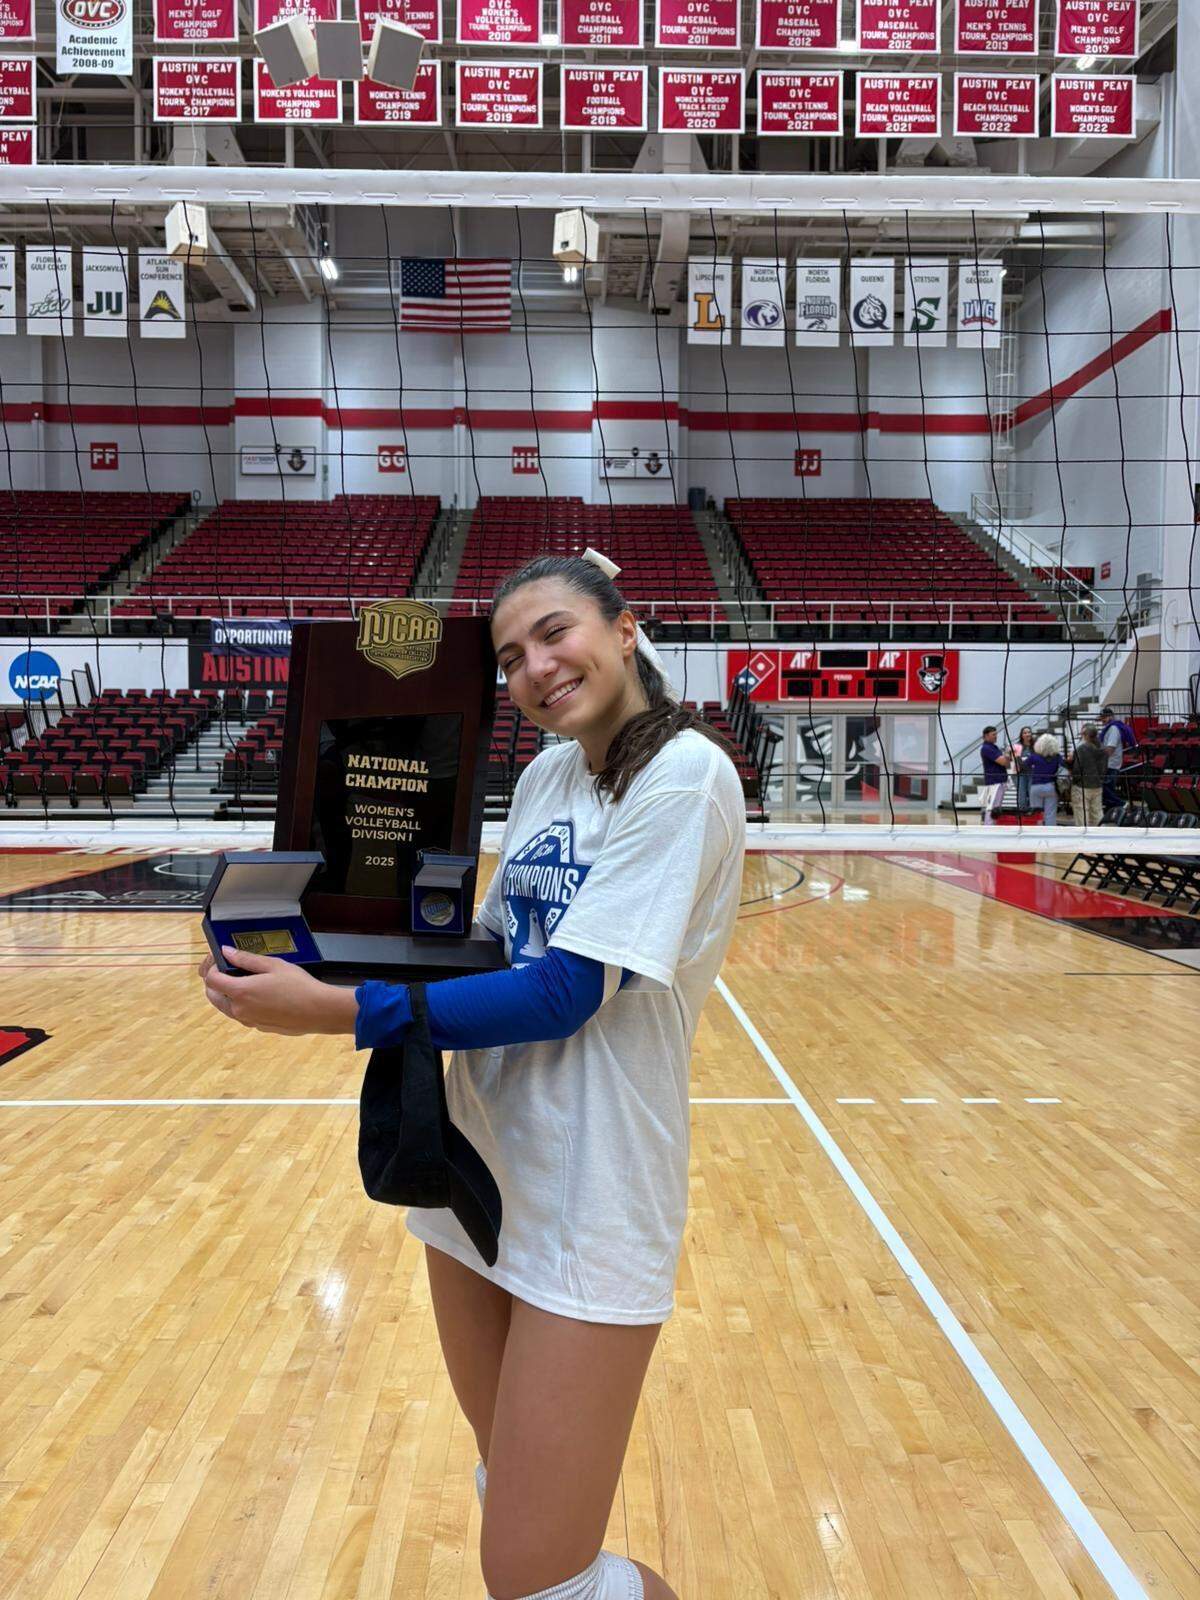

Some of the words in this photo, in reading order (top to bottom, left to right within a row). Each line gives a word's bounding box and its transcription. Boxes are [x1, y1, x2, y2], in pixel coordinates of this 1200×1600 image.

[386, 0, 411, 8] OVC
[489, 0, 512, 9] OVC
[590, 3, 612, 12] OVC
[687, 3, 710, 12] OVC
[1005, 0, 1030, 8] PEAY
[1065, 1, 1100, 10] AUSTIN
[1107, 2, 1131, 11] PEAY
[74, 1, 112, 17] OVC
[481, 8, 519, 16] WOMEN'S
[788, 5, 810, 14] OVC
[888, 9, 910, 18] OVC
[169, 10, 192, 18] MEN'S
[202, 10, 222, 18] GOLF
[407, 12, 434, 20] TENNIS
[986, 10, 1008, 19] OVC
[1087, 13, 1109, 22] OVC
[174, 20, 218, 28] CHAMPIONS
[475, 16, 524, 24] VOLLEYBALL
[579, 15, 621, 24] BASEBALL
[677, 15, 718, 25] BASEBALL
[778, 18, 819, 26] BASEBALL
[496, 24, 532, 32] CHAMPIONS
[577, 25, 624, 34] CHAMPIONS
[877, 21, 919, 30] BASEBALL
[966, 22, 991, 31] MEN'S
[998, 23, 1026, 31] TENNIS
[1070, 25, 1096, 34] MEN'S
[1103, 26, 1125, 34] GOLF
[691, 27, 735, 35] CHAMPIONS
[776, 28, 821, 37] CHAMPIONS
[69, 35, 118, 45] Academic
[488, 32, 512, 40] 2010
[590, 35, 611, 43] 2011
[688, 35, 709, 44] 2011
[891, 32, 935, 40] CHAMPIONS
[960, 32, 988, 40] TOURN.
[991, 33, 1034, 41] CHAMPIONS
[1075, 36, 1121, 44] CHAMPIONS
[788, 37, 812, 46] 2012
[888, 40, 912, 49] 2012
[985, 41, 1009, 50] 2013
[61, 47, 125, 57] Achievement
[1085, 45, 1109, 53] 2013
[1, 62, 28, 72] PEAY
[72, 58, 114, 69] 2008-09
[162, 63, 198, 73] AUSTIN
[206, 63, 233, 73] PEAY
[464, 68, 500, 78] AUSTIN
[508, 69, 535, 79] PEAY
[569, 71, 605, 81] AUSTIN
[613, 72, 639, 82] PEAY
[186, 75, 208, 84] OVC
[667, 74, 703, 84] AUSTIN
[711, 74, 737, 84] PEAY
[765, 77, 801, 86] AUSTIN
[809, 77, 835, 87] PEAY
[488, 80, 510, 90] OVC
[593, 83, 615, 93] OVC
[864, 79, 900, 89] AUSTIN
[908, 80, 933, 89] PEAY
[962, 79, 998, 88] AUSTIN
[1005, 80, 1031, 90] PEAY
[1059, 80, 1095, 90] AUSTIN
[1103, 81, 1128, 91] PEAY
[159, 88, 190, 96] WOMEN'S
[192, 88, 235, 96] VOLLEYBALL
[369, 91, 400, 99] WOMEN'S
[691, 86, 713, 95] OVC
[789, 88, 811, 98] OVC
[470, 93, 501, 101] WOMEN'S
[503, 94, 528, 102] TENNIS
[888, 91, 910, 100] OVC
[986, 91, 1008, 100] OVC
[1083, 92, 1104, 101] OVC
[191, 98, 235, 107] CHAMPIONS
[276, 100, 321, 108] CHAMPIONS
[586, 97, 621, 105] FOOTBALL
[772, 101, 802, 110] WOMEN'S
[804, 102, 829, 110] TENNIS
[376, 102, 420, 110] CHAMPIONS
[493, 104, 536, 112] CHAMPIONS
[866, 103, 889, 112] BEACH
[890, 104, 932, 112] VOLLEYBALL
[963, 103, 987, 112] BEACH
[988, 104, 1030, 112] VOLLEYBALL
[1069, 105, 1099, 113] WOMEN'S
[1101, 105, 1118, 113] GOLF
[183, 107, 210, 116] 2017
[285, 109, 312, 117] 2018
[385, 111, 411, 120] 2019
[582, 107, 625, 115] CHAMPIONS
[486, 112, 513, 122] 2019
[590, 116, 617, 125] 2019
[794, 112, 838, 120] CHAMPIONS
[892, 114, 935, 122] CHAMPIONS
[974, 114, 1018, 122] CHAMPIONS
[1072, 115, 1115, 123] CHAMPIONS
[687, 119, 716, 128] 2020
[787, 120, 813, 130] 2021
[885, 122, 912, 132] 2021
[981, 122, 1011, 132] 2022
[1079, 123, 1108, 132] 2022
[2, 132, 28, 142] PEAY
[141, 273, 182, 281] CONFERENCE
[861, 275, 884, 283] QUEENS
[87, 291, 123, 316] JU
[694, 293, 725, 331] L
[93, 448, 116, 465] FF
[379, 450, 405, 467] GG
[514, 452, 538, 468] HH
[361, 611, 439, 645] NJCAA
[202, 653, 289, 682] AUSTIN
[14, 675, 59, 689] NCAA
[347, 754, 429, 774] NATIONAL
[345, 773, 429, 793] CHAMPION
[354, 804, 415, 817] WOMEN'S
[344, 815, 421, 830] VOLLEYBALL
[352, 828, 406, 841] DIVISION
[408, 833, 413, 841] I
[365, 855, 395, 866] 2025
